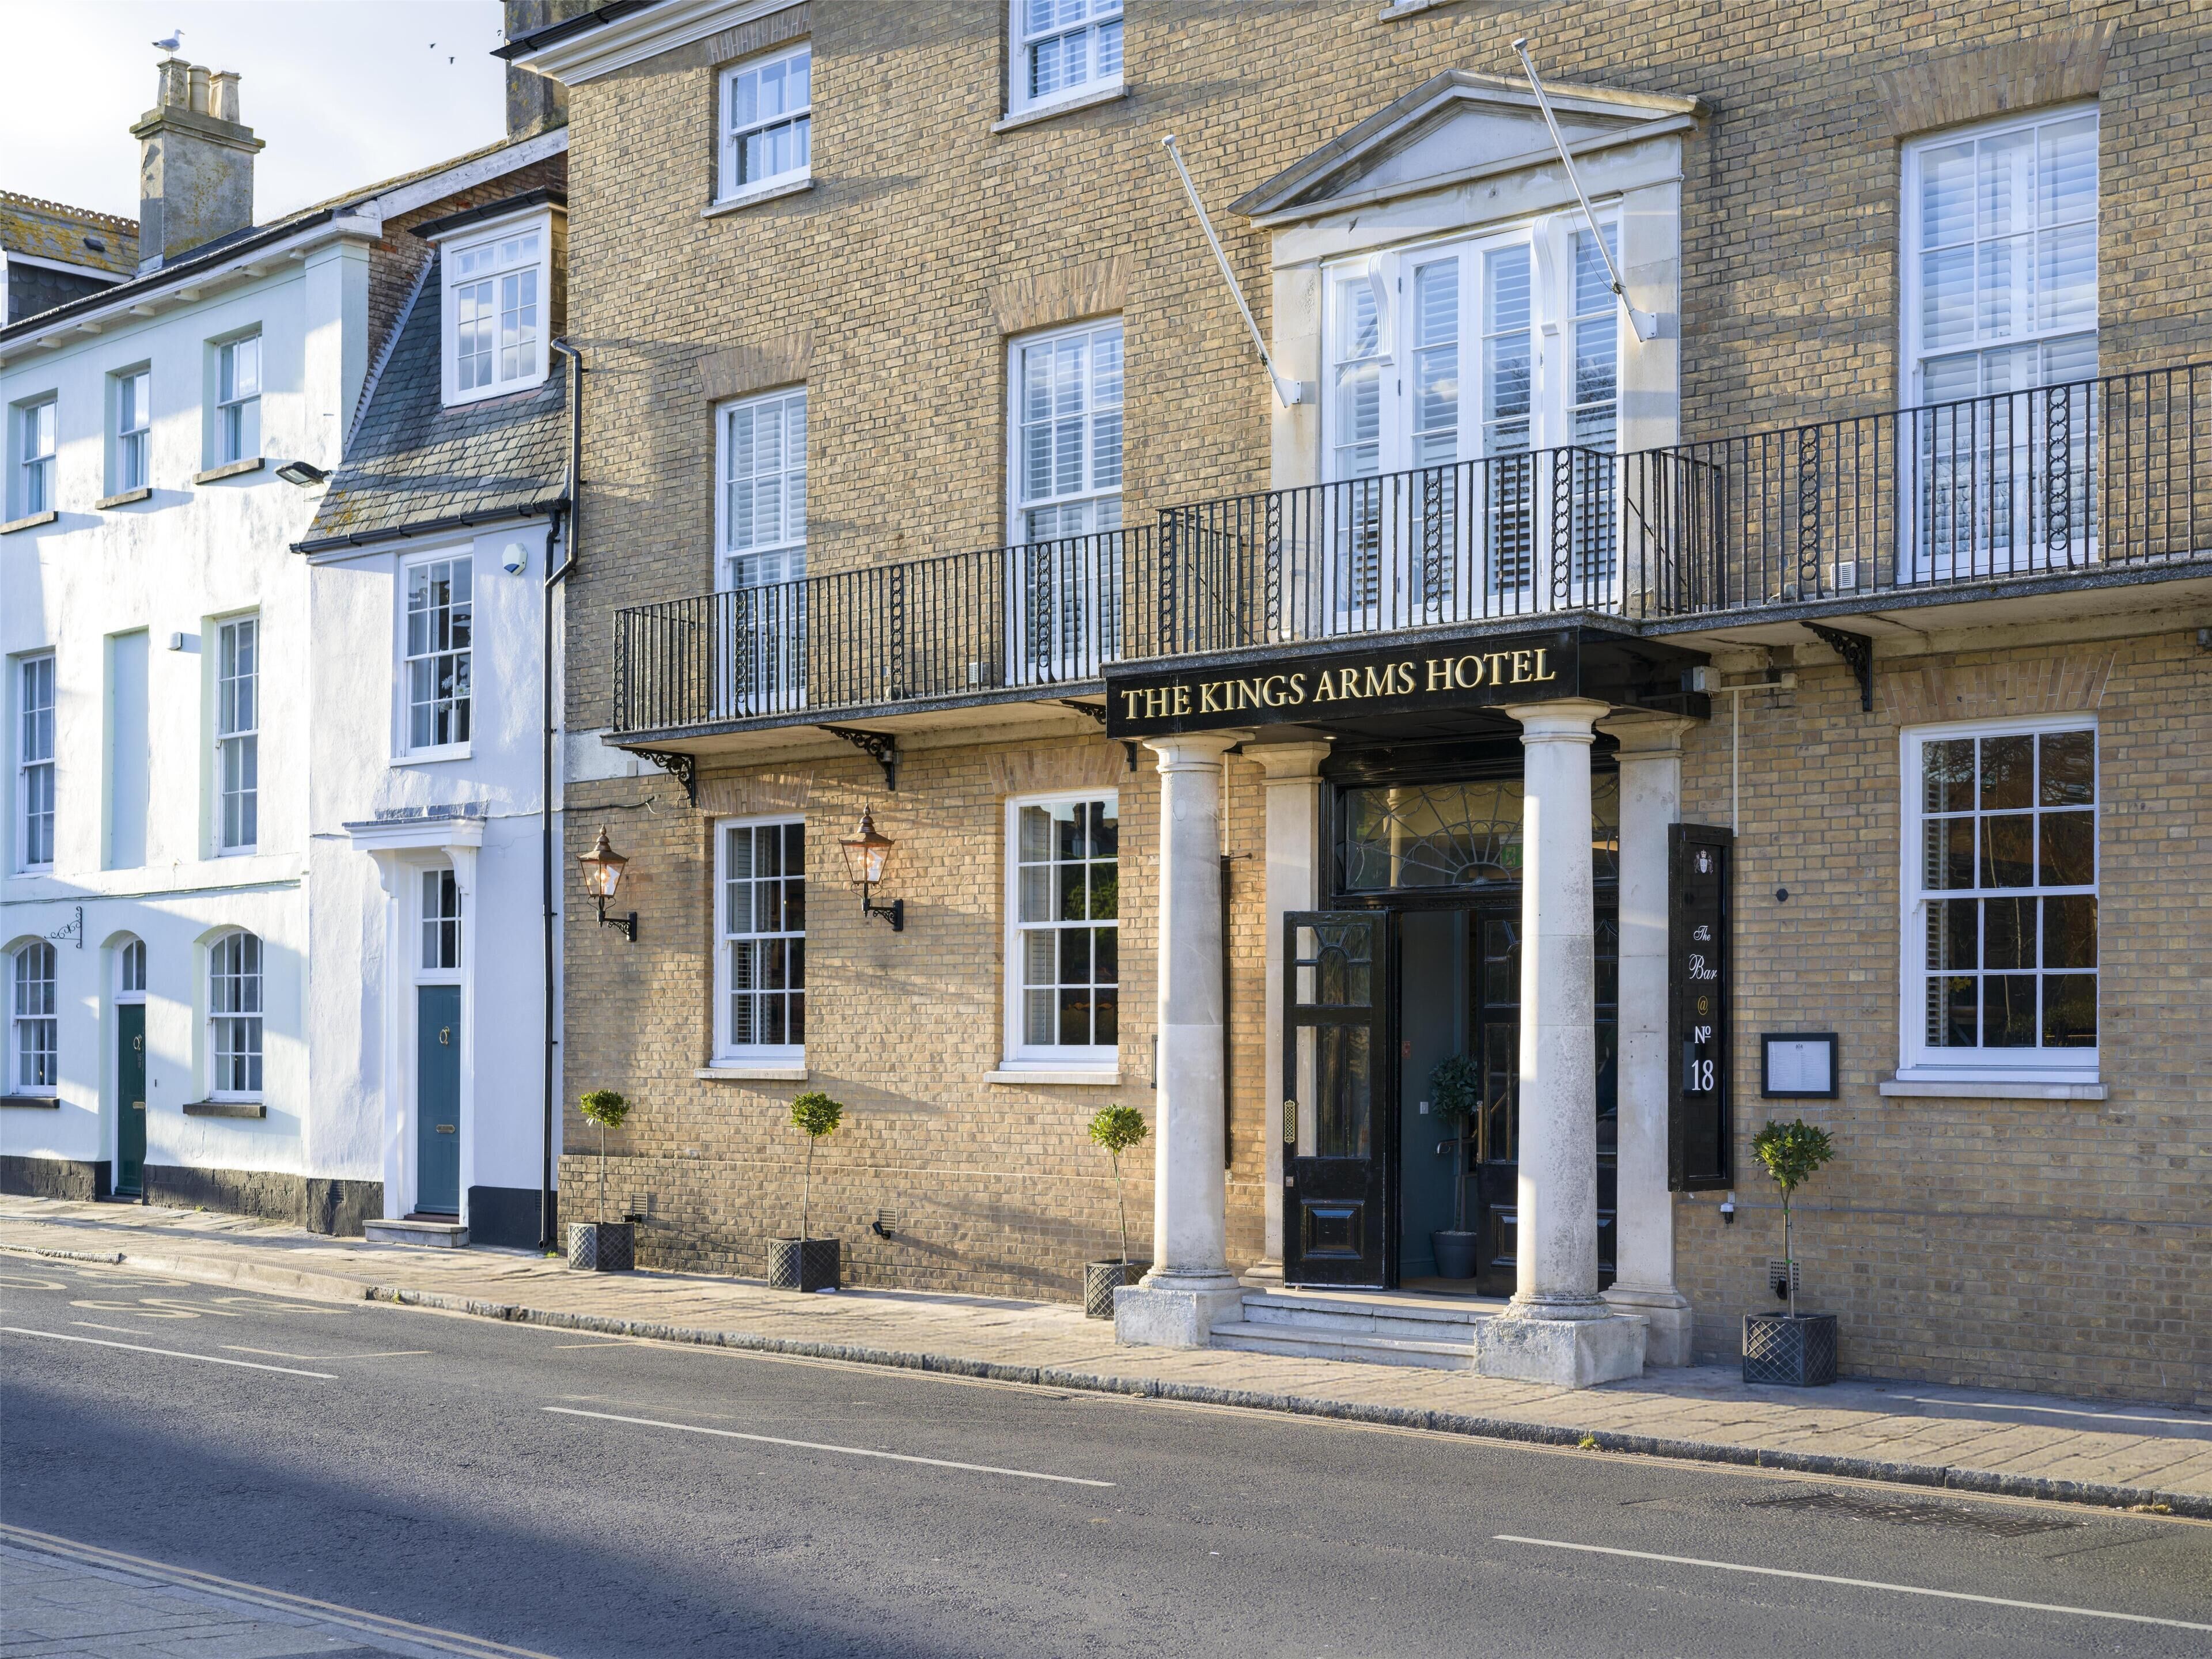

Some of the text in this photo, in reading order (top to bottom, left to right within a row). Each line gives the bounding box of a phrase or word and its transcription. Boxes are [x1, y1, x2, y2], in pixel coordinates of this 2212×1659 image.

[1121, 648, 1556, 719] THE KINGS ARMS HOTEL
[1693, 925, 1711, 941] The
[1688, 953, 1717, 980] Bar
[1698, 995, 1709, 1015] @
[1691, 1059, 1714, 1091] 18
[69, 1296, 353, 1318] BUS
